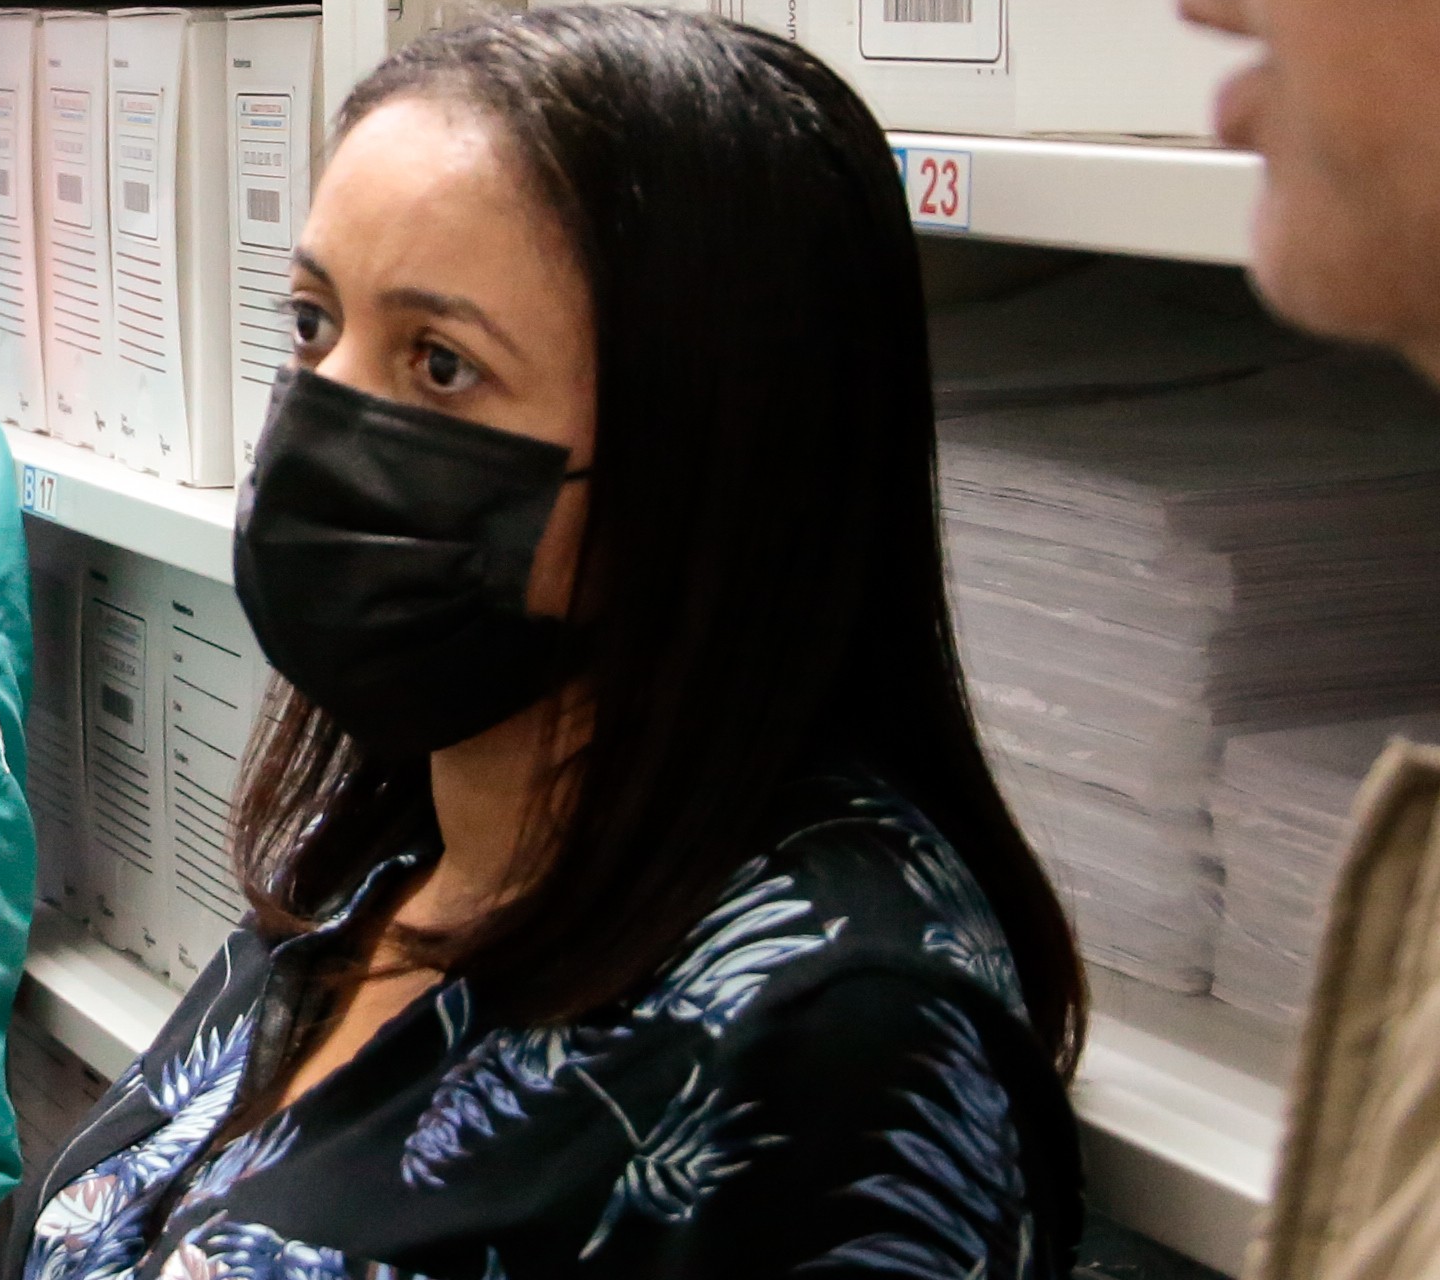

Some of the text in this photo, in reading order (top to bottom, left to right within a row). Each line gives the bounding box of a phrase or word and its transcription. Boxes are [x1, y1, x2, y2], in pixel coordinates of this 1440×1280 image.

[919, 158, 960, 217] 23
[25, 471, 55, 510] B 17
